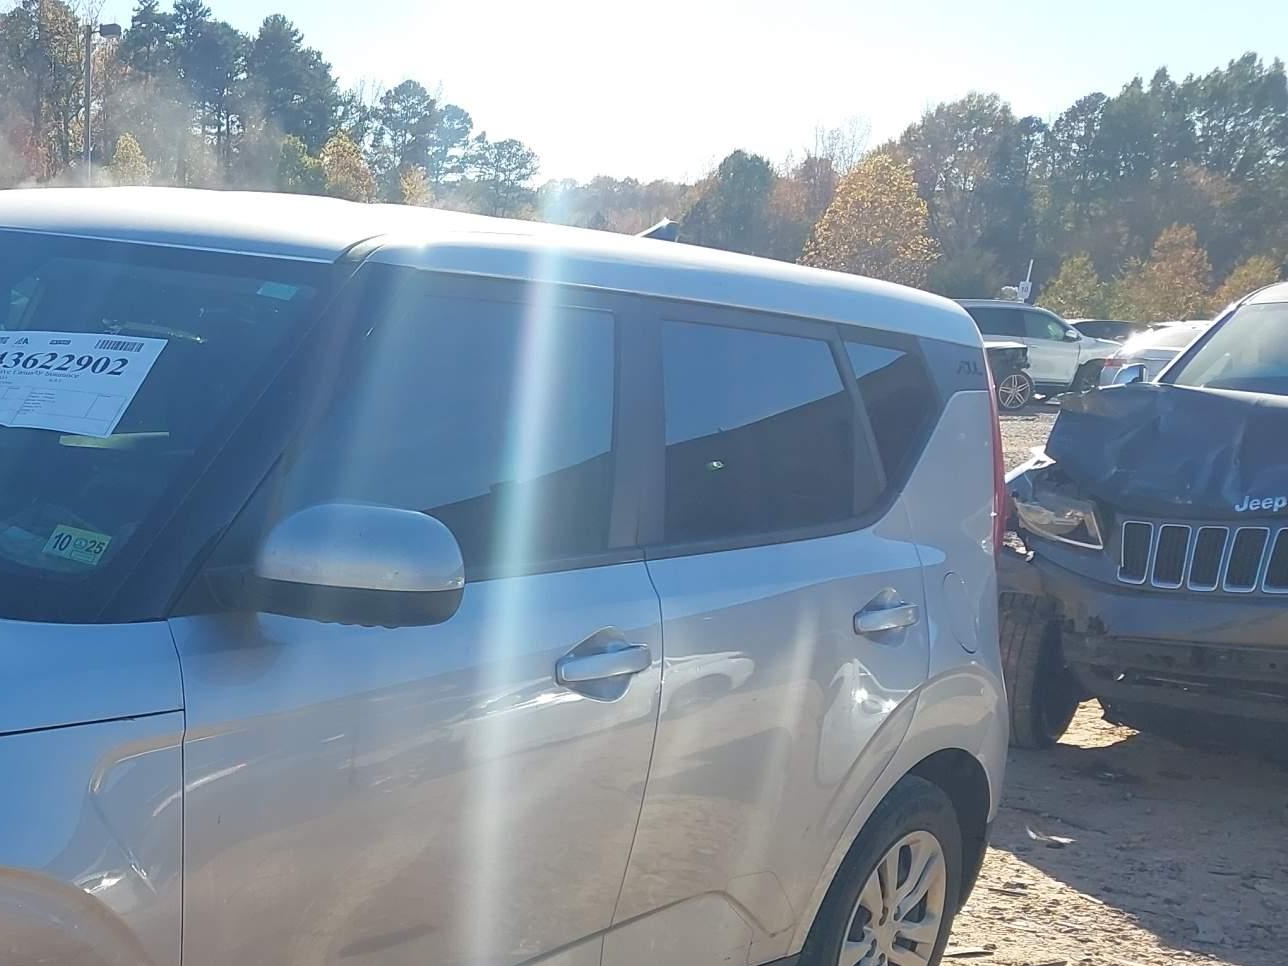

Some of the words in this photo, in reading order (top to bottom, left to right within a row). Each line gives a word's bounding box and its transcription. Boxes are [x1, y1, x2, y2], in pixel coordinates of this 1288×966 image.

[1234, 495, 1288, 512] Jeep
[53, 533, 72, 551] 10
[85, 540, 105, 554] 25
